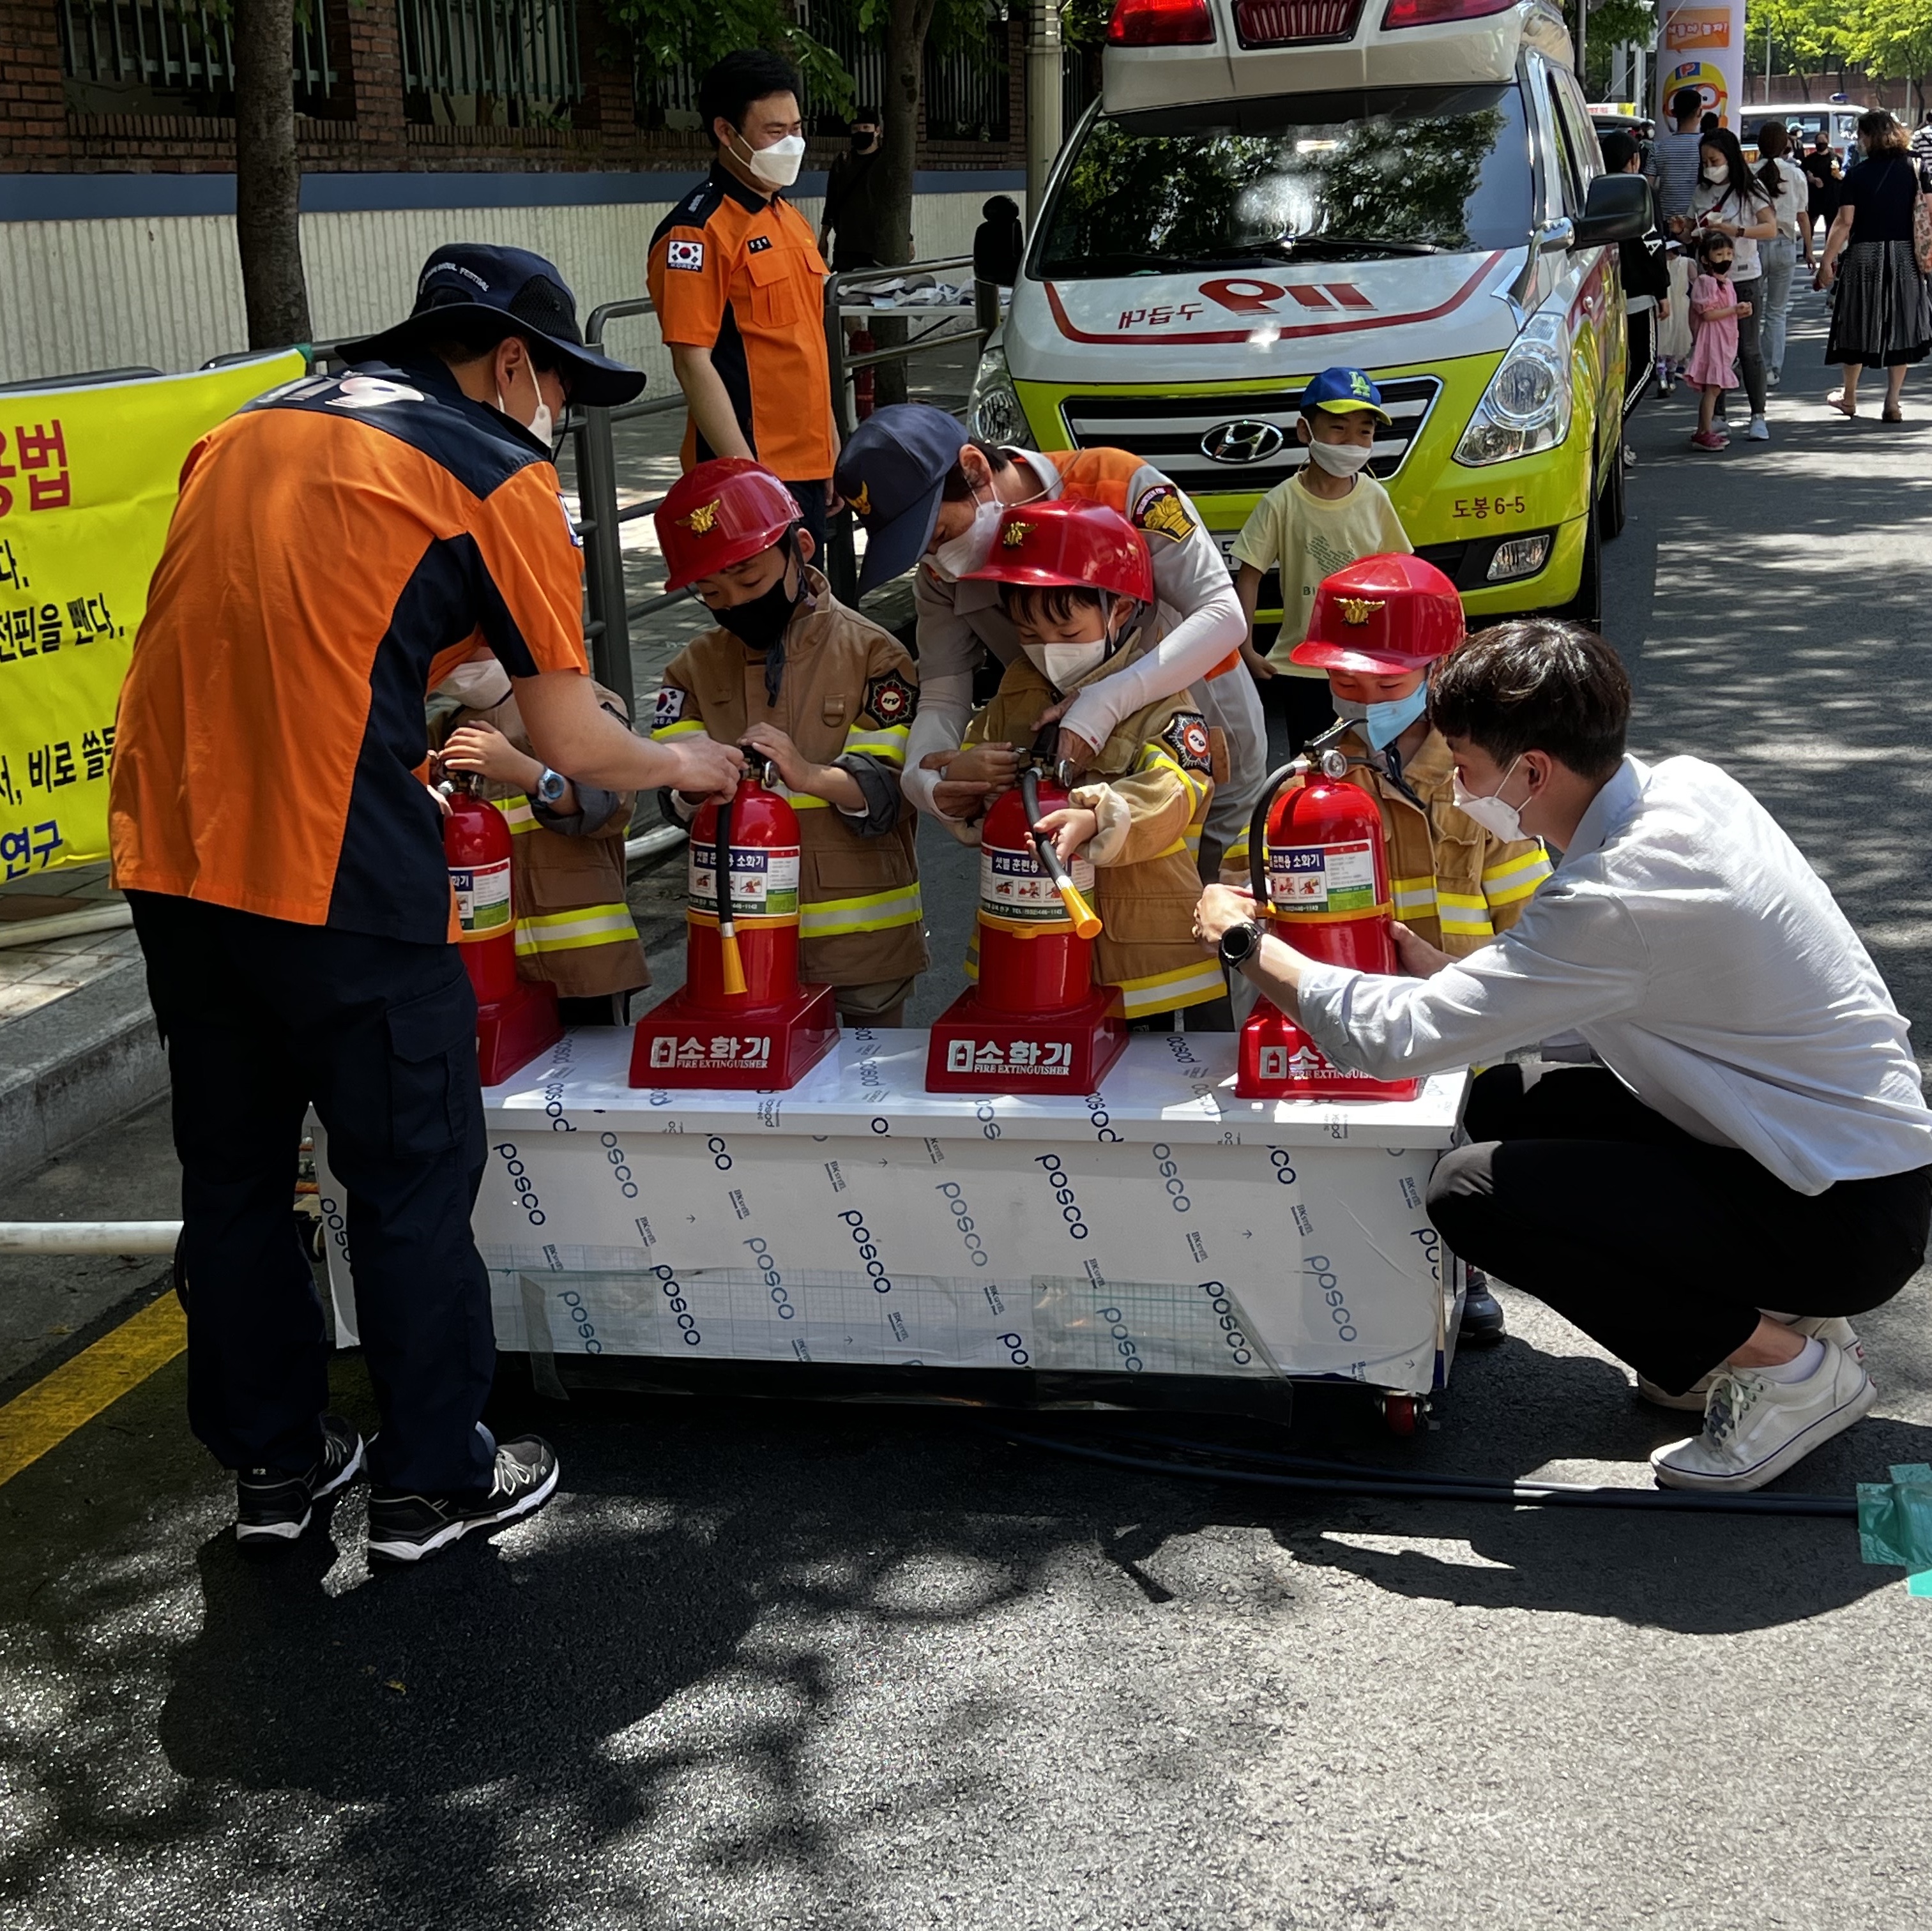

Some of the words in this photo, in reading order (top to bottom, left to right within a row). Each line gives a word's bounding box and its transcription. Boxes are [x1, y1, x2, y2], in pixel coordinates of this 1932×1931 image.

[1348, 371, 1371, 398] LA
[1452, 497, 1491, 519] 도봉
[1495, 496, 1525, 515] 6-5
[28, 741, 77, 794] 비로
[0, 819, 64, 881] 연구
[737, 854, 764, 869] 소화기
[1293, 853, 1320, 868] 소화기
[676, 1059, 698, 1068] FIRE
[699, 1059, 768, 1069] EXTINGUISHER
[677, 1036, 770, 1059] 소화기
[974, 1064, 996, 1073] FIRE
[998, 1064, 1070, 1075] EXTINGUISHER
[975, 1040, 1072, 1066] 소화기
[493, 1143, 546, 1225] posco
[1034, 1154, 1088, 1239] posco
[838, 1210, 892, 1293] posco
[935, 1181, 988, 1267] posco
[649, 1264, 701, 1345] posco
[743, 1237, 795, 1320] posco
[1303, 1255, 1357, 1342] posco
[1198, 1281, 1252, 1365] posco
